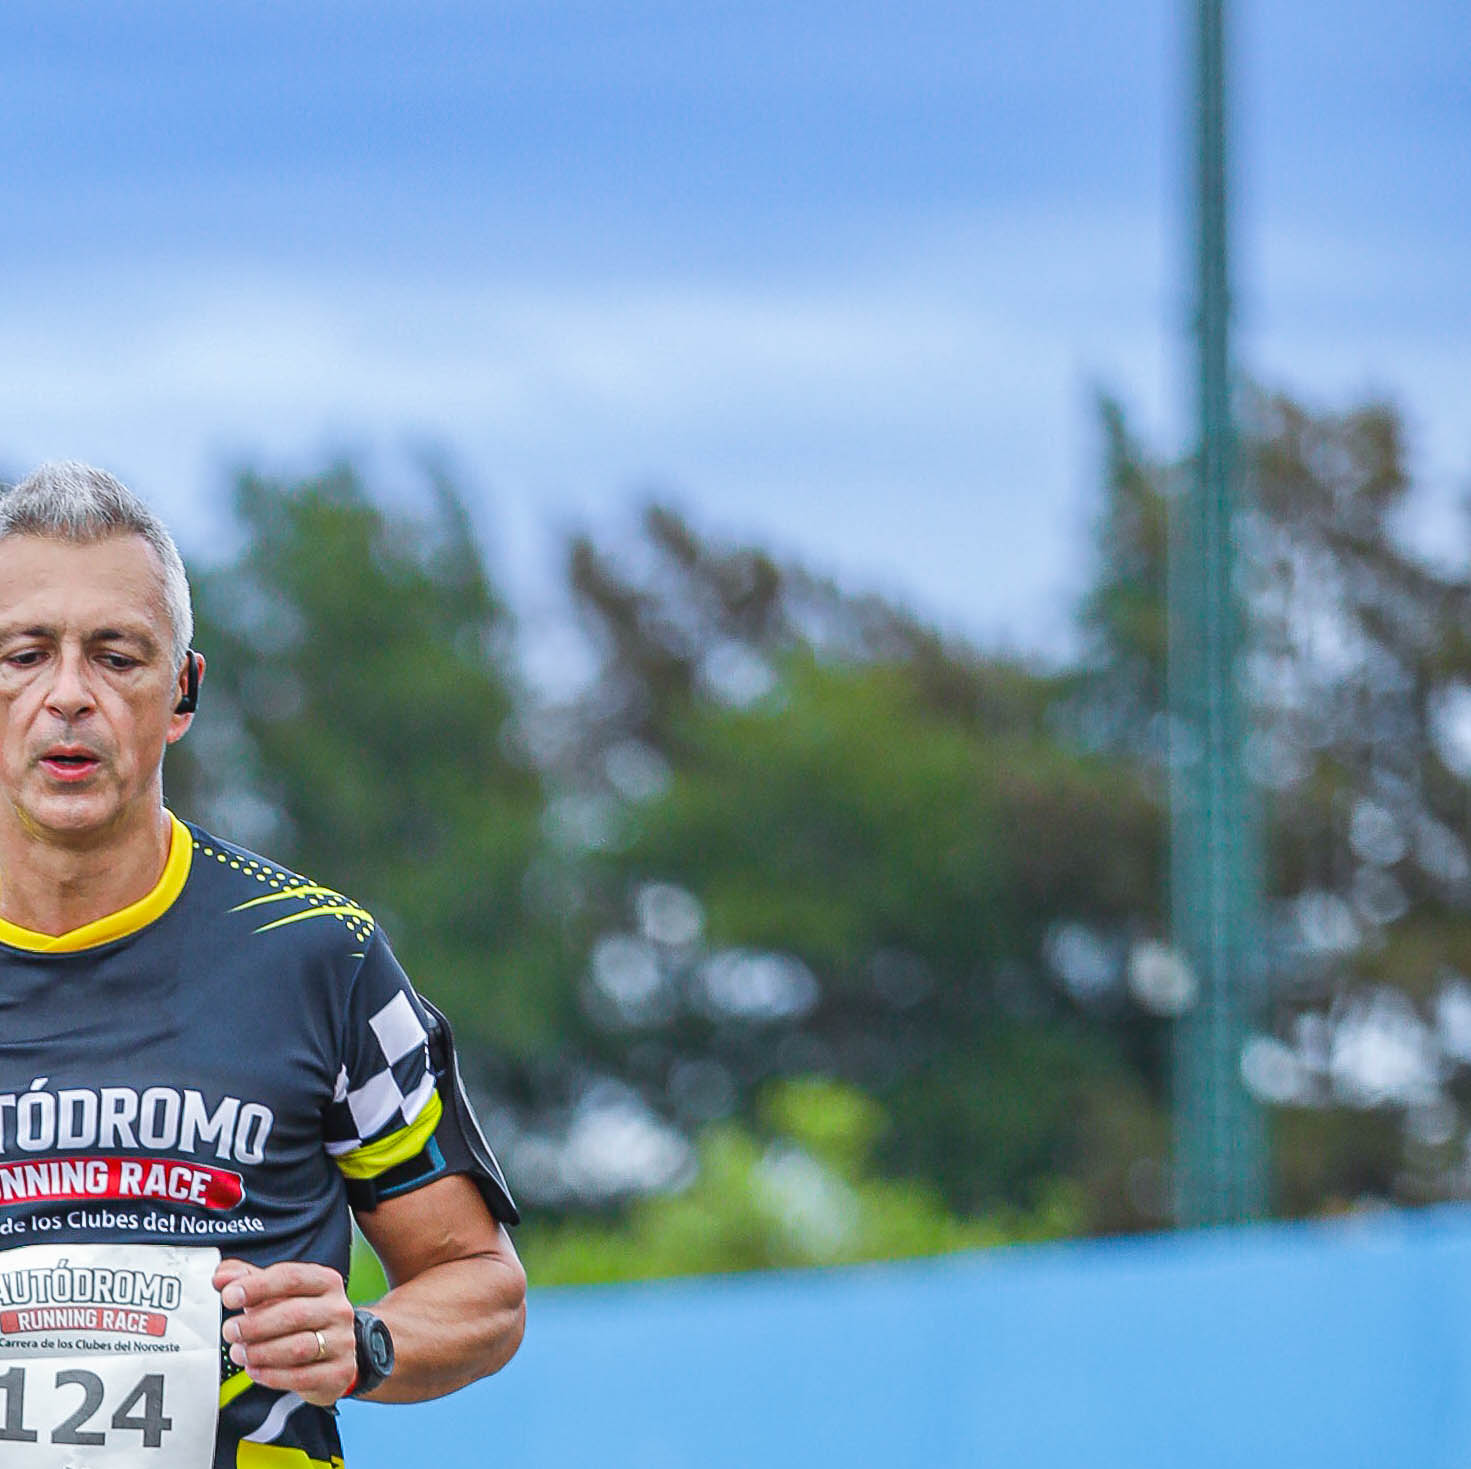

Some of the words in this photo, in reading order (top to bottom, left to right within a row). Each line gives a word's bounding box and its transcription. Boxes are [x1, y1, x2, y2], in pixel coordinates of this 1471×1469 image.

[118, 1162, 213, 1205] RACE
[0, 1217, 26, 1235] de
[32, 1216, 62, 1231] los
[67, 1210, 139, 1230] Clubes
[143, 1212, 176, 1233] del
[181, 1215, 265, 1234] Noroeste
[18, 1308, 97, 1332] RUNNING
[103, 1308, 148, 1334] RACE
[41, 1338, 55, 1349] de
[57, 1338, 74, 1349] los
[75, 1338, 112, 1351] Clubes
[114, 1340, 131, 1352] del
[133, 1341, 180, 1353] Noroeste
